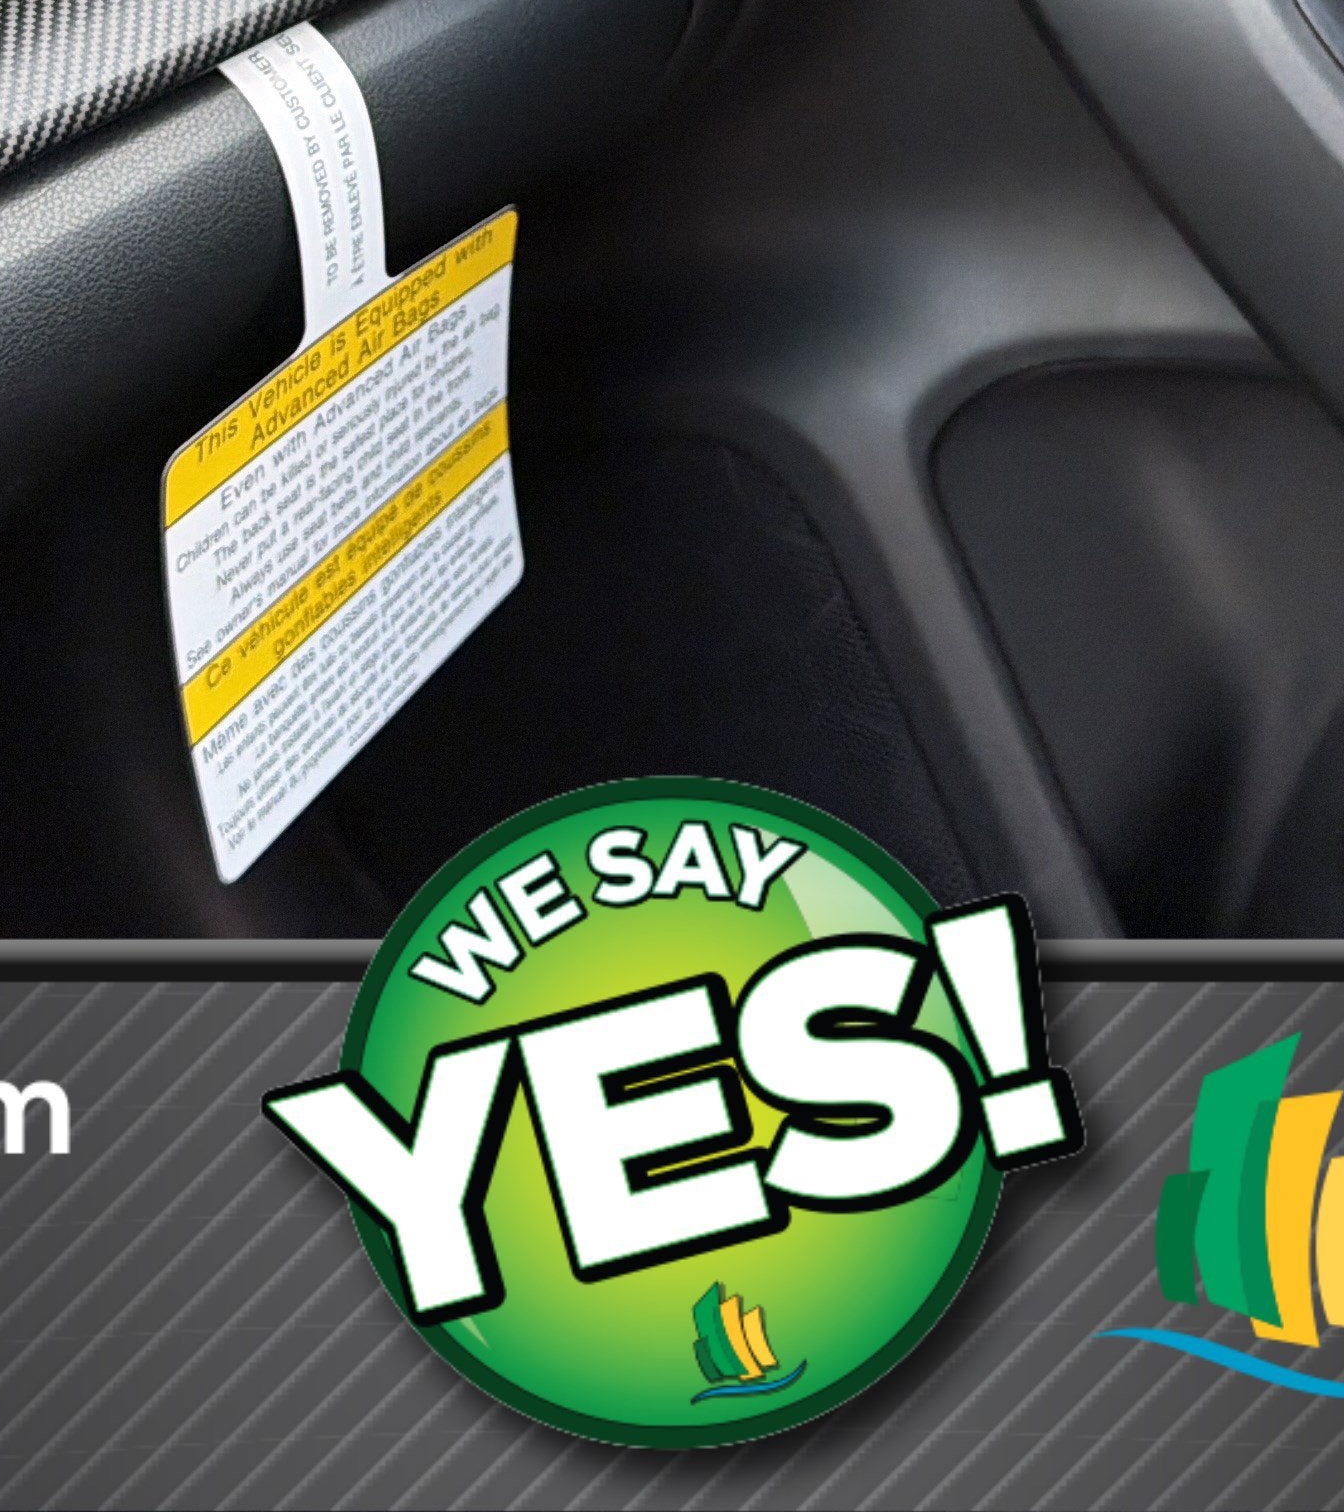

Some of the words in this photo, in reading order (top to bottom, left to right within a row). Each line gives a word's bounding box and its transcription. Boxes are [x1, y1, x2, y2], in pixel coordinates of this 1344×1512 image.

[247, 52, 310, 130] CUSTOMER
[296, 58, 336, 108] CLIENT
[305, 135, 320, 156] BY
[329, 109, 346, 134] LE
[337, 136, 354, 169] PAR
[312, 159, 335, 236] REMOVED
[325, 244, 338, 261] BE
[326, 263, 339, 287] TO
[195, 417, 239, 464] This
[247, 350, 322, 419] Vehicle
[330, 330, 346, 357] is
[355, 252, 447, 340] Equipped
[455, 227, 492, 265] with
[219, 464, 265, 512] Even
[271, 430, 306, 468] with
[312, 356, 393, 436] Advanced
[398, 337, 421, 367] Air
[427, 304, 466, 345] Bags
[249, 351, 350, 451] Advanced
[357, 328, 385, 364] Air
[392, 289, 440, 338] Bags
[175, 521, 229, 574] Children
[234, 498, 256, 527] can
[260, 482, 276, 504] be
[280, 449, 311, 487] killed
[315, 438, 327, 459] or
[331, 396, 380, 448] seriously
[384, 360, 421, 403] injured
[424, 350, 436, 372] by
[441, 334, 458, 357] the
[463, 320, 474, 341] air
[212, 538, 238, 566] The
[241, 509, 271, 544] back
[276, 482, 301, 515] seat
[305, 473, 315, 491] is
[319, 454, 337, 479] the
[342, 421, 376, 460] safest
[379, 396, 408, 432] place
[412, 380, 425, 403] for
[216, 550, 251, 591] Never
[256, 527, 277, 560] put
[280, 520, 289, 536] a
[293, 464, 354, 527] rear-facing
[357, 437, 382, 472] child
[386, 416, 409, 447] seat
[426, 389, 443, 412] the
[229, 558, 273, 606] Always
[276, 536, 298, 564] use
[302, 509, 327, 541] seat
[330, 485, 357, 517] belts
[361, 460, 382, 491] and
[385, 437, 410, 470] child
[186, 639, 212, 671] See
[215, 592, 263, 644] owner's
[267, 548, 309, 598] manual
[312, 532, 328, 556] for
[332, 504, 360, 540] more
[205, 656, 232, 691] Ce
[238, 585, 308, 660] véhicule
[315, 553, 340, 591] est
[403, 481, 422, 510] de
[428, 419, 490, 488] coussins
[272, 568, 356, 663] gonflables
[202, 712, 248, 765] Même
[253, 674, 286, 717] avec
[290, 646, 316, 680] des
[320, 588, 375, 652] coussins
